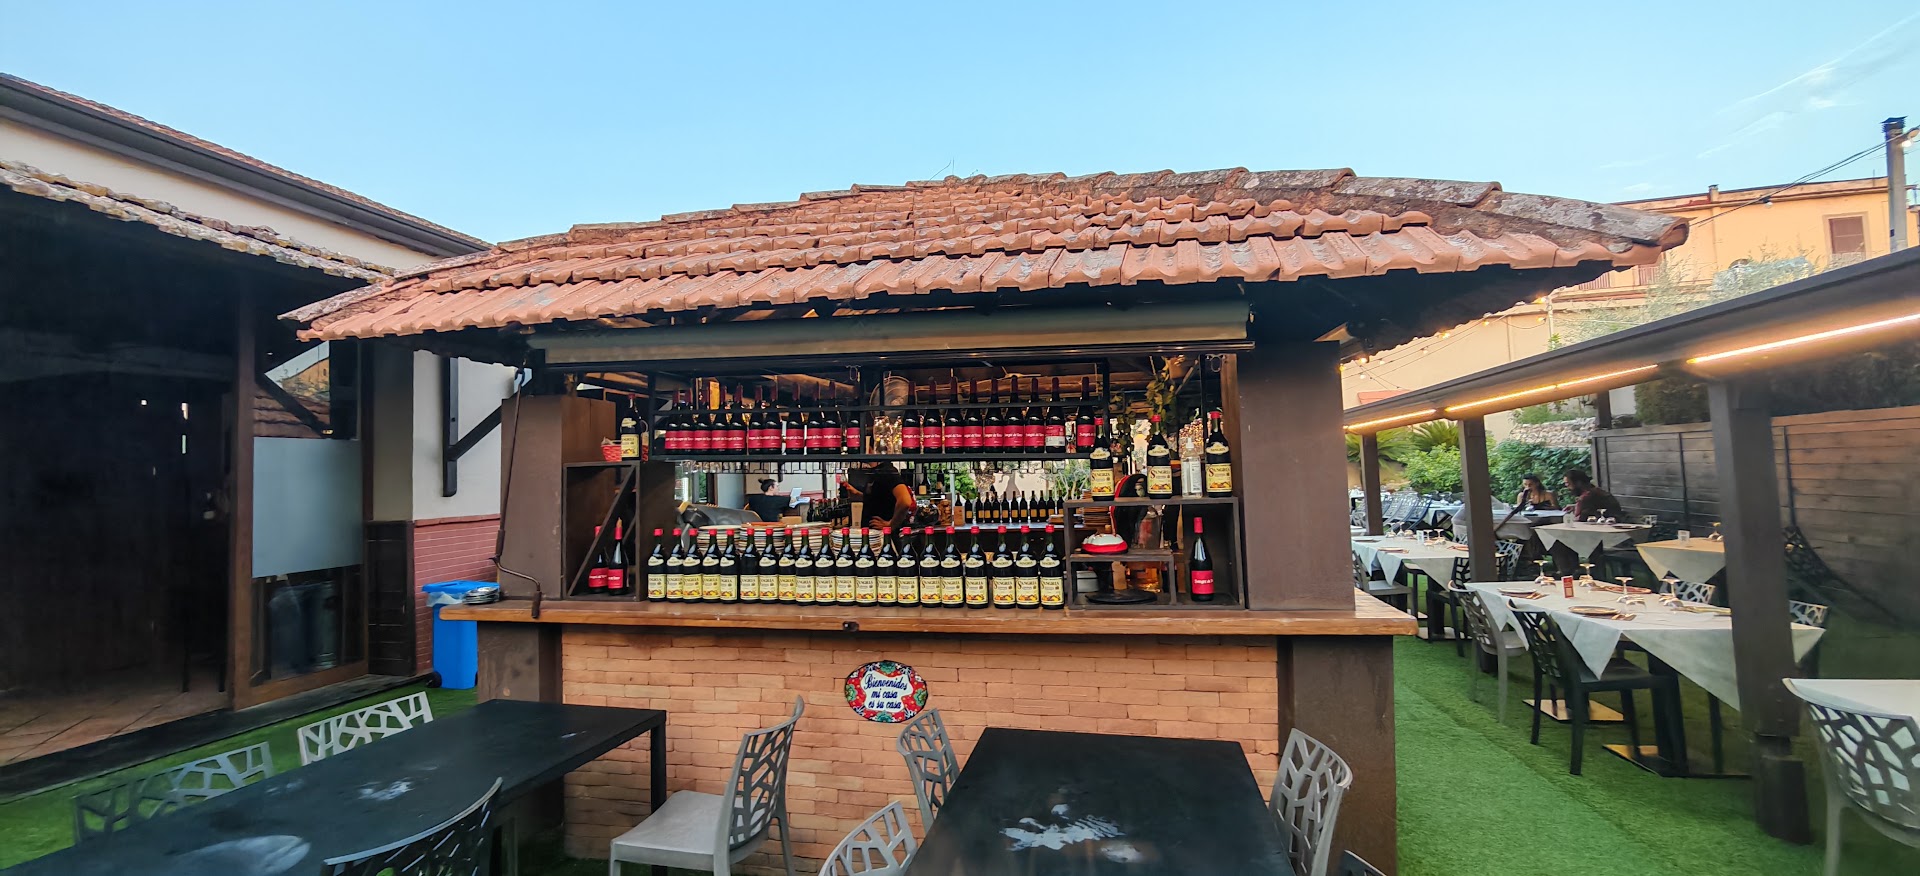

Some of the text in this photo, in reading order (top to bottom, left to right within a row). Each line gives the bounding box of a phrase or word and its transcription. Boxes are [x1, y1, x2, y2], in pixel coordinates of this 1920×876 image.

[864, 674, 907, 690] Bienvenidos
[871, 688, 881, 698] mi
[886, 700, 902, 709] casa
